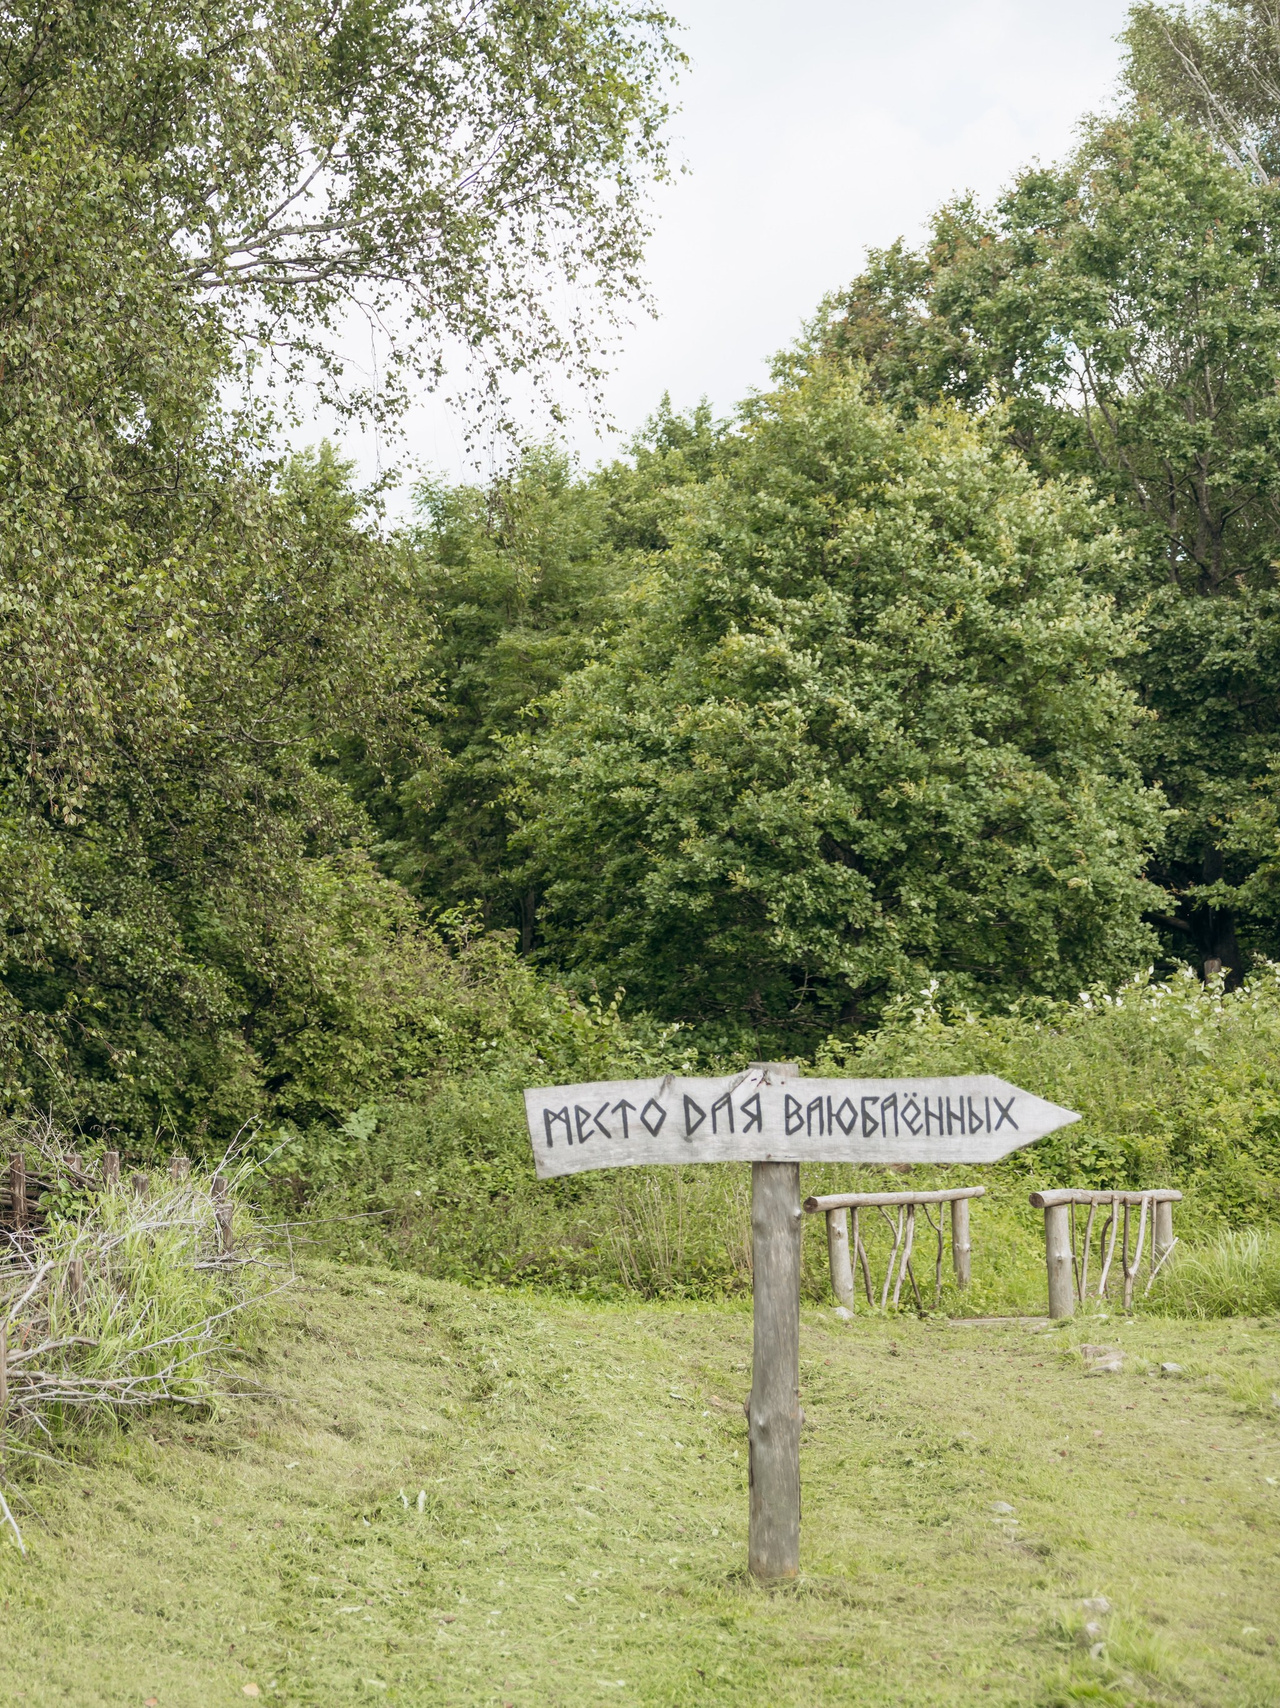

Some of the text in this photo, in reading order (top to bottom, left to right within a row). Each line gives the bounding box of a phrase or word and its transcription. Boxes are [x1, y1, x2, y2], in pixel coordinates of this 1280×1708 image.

[542, 1091, 1020, 1149] МЕСТО ДЛЯ ВЛЮБЛЁННЫХ
